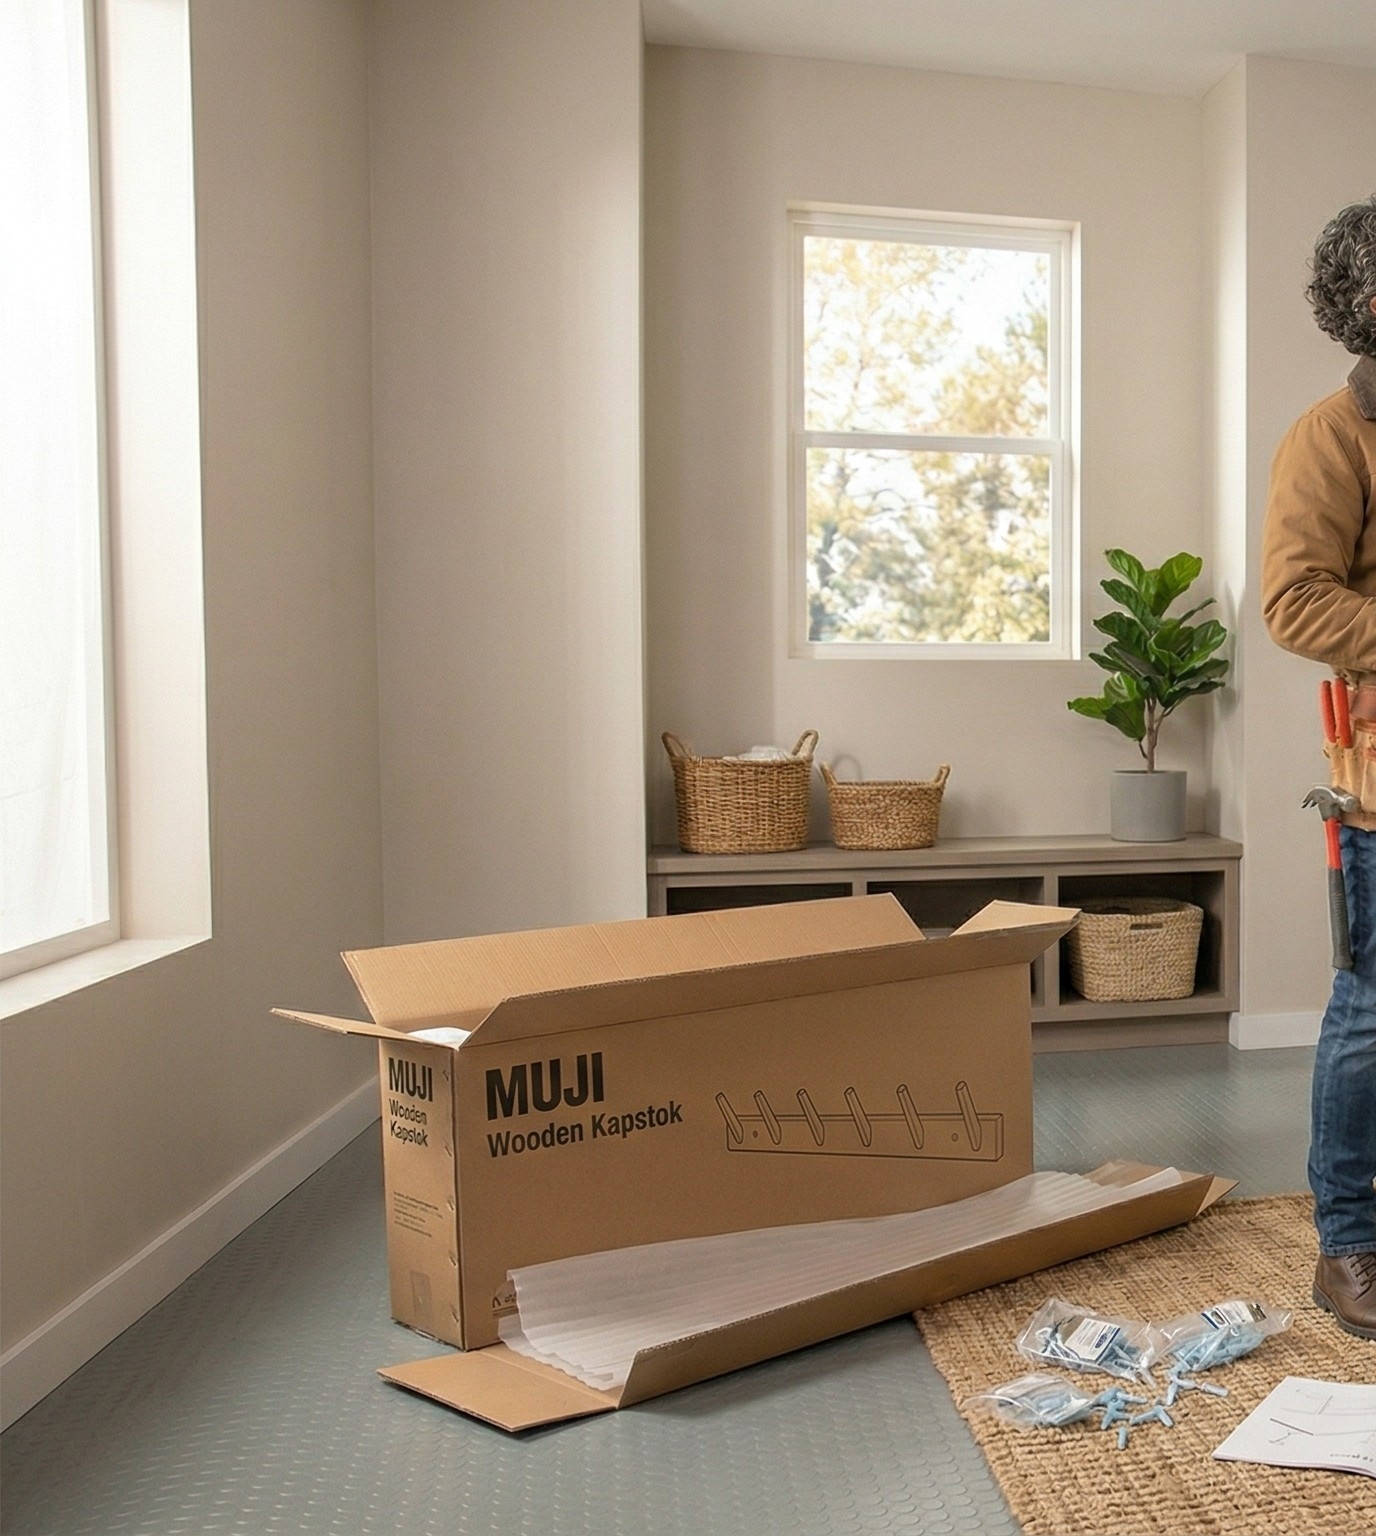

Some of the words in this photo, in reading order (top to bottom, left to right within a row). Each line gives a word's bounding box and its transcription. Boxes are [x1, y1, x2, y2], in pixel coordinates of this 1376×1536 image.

[388, 1057, 433, 1102] MUJI
[485, 1051, 605, 1121] MUJI
[487, 1122, 584, 1158] Wooden
[591, 1100, 683, 1138] Kapstok
